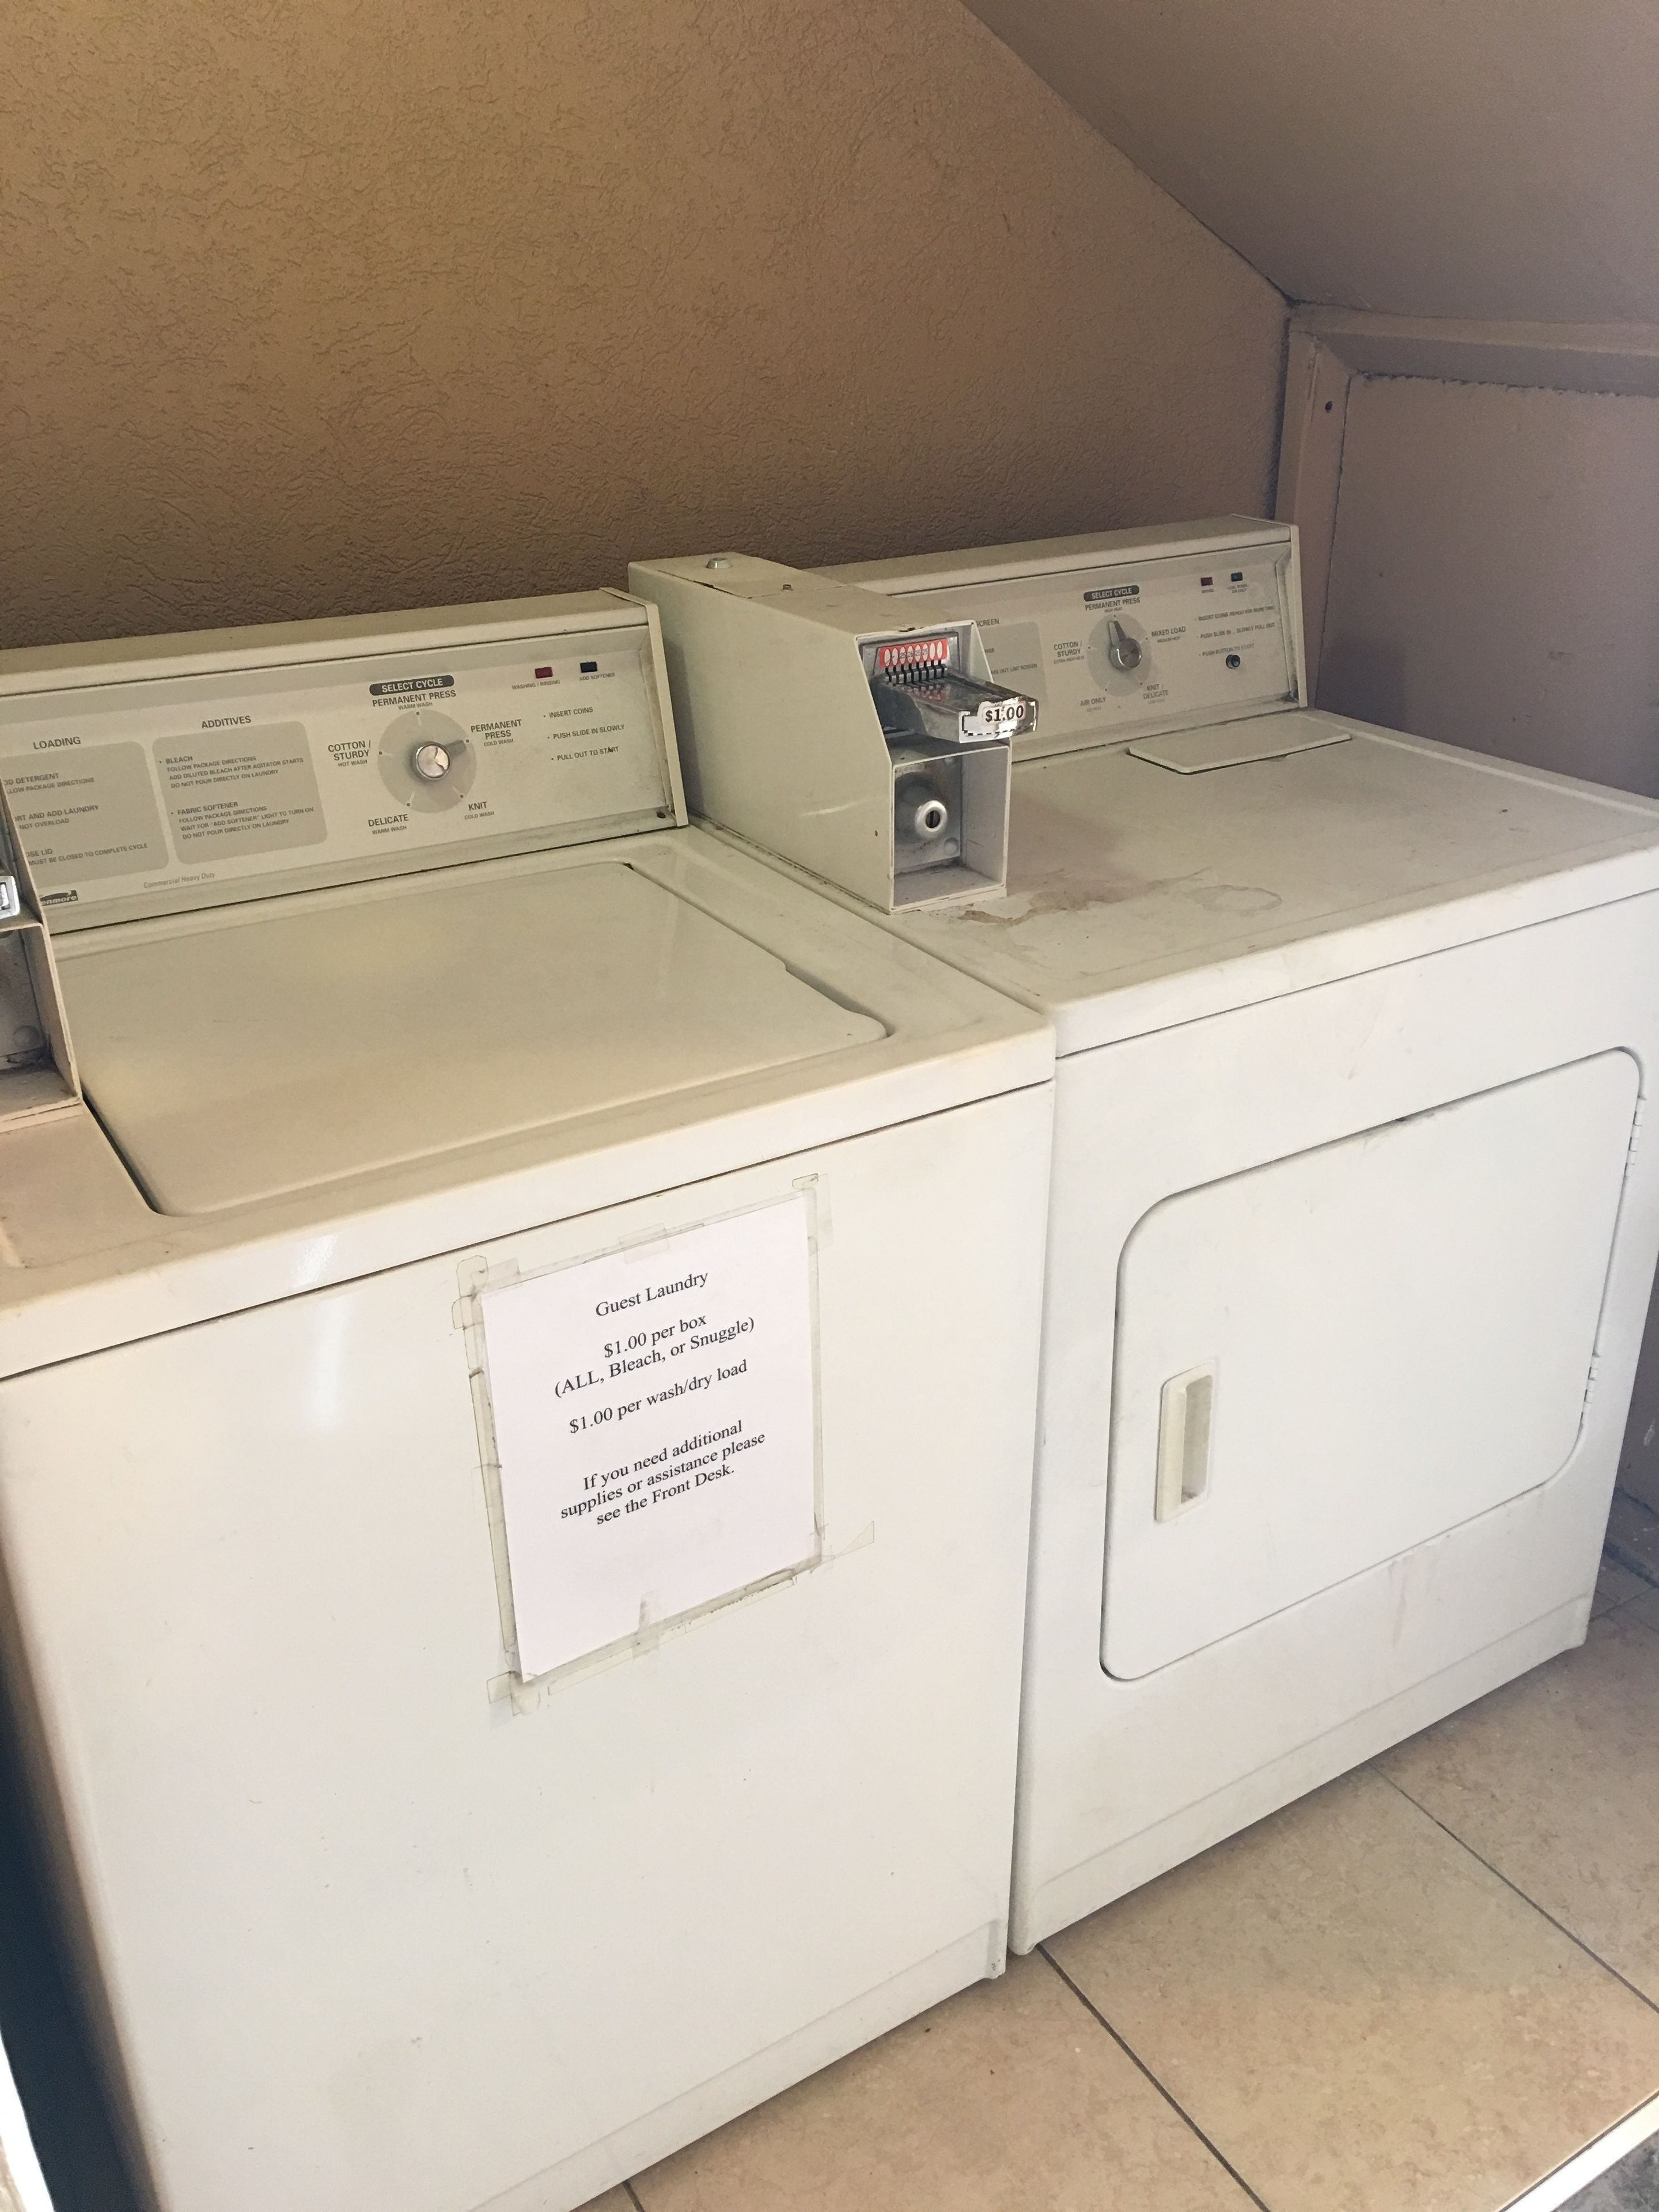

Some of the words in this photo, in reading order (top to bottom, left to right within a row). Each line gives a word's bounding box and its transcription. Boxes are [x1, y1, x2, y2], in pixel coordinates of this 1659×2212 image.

[1092, 591, 1112, 599] SELECT
[1114, 588, 1132, 596] CYCLE
[1085, 600, 1120, 611] PERMANENT
[976, 618, 999, 627] SCREEN
[1152, 628, 1169, 637] MIXED
[1054, 642, 1078, 650] COTTON
[1058, 649, 1080, 657] STURDY
[382, 681, 413, 692] SELECT
[416, 679, 443, 688] CYCLE
[372, 694, 426, 707] PERMANENT
[429, 690, 456, 699] PRESS
[1143, 690, 1169, 699] DELICATE
[549, 710, 571, 718] INSERT
[573, 707, 593, 715] COINS
[984, 704, 1024, 723] $1.00
[202, 715, 251, 729] ADDITIVES
[471, 719, 522, 733] PERMANENT
[485, 730, 512, 740] PRESS
[600, 725, 624, 733] SLOWLY
[33, 736, 81, 749] LOADING
[328, 741, 366, 752] COTTON
[166, 756, 193, 764] BLEACH
[334, 749, 369, 761] STURDY
[194, 760, 220, 769] PACKAGE
[222, 756, 256, 765] DIRECTIONS
[210, 767, 232, 775] BLEACH
[253, 760, 281, 769] AGITATOR
[16, 773, 59, 784] DETERGENT
[213, 774, 239, 783] DIRECTLY
[252, 769, 278, 777] LAUNDRY
[26, 783, 55, 791] PACKAGE
[58, 778, 94, 787] DIRECTIONS
[65, 805, 99, 815] LAUNDRY
[177, 807, 201, 815] FABRIC
[203, 801, 238, 812] SOFTENER
[468, 801, 487, 811] KNIT
[204, 812, 232, 820] PACKAGE
[233, 806, 267, 816] DIRECTIONS
[35, 818, 70, 828] OVERLOAD
[225, 825, 251, 834] DIRECTLY
[263, 819, 289, 827] LAUNDRY
[368, 814, 409, 827] DELICATE
[59, 853, 83, 861] CLOSED
[95, 846, 127, 856] COMPLETE
[143, 877, 180, 889] Commercial
[181, 874, 200, 883] Heavy
[41, 895, 77, 906] enmore
[596, 1293, 642, 1316] Guest
[646, 1272, 709, 1302] Laundry
[604, 1332, 647, 1358] $1.00
[652, 1325, 676, 1346] per
[679, 1314, 708, 1332] box
[554, 1369, 605, 1398] (ALL,
[609, 1351, 666, 1378] Bleach,
[670, 1342, 686, 1357] or
[691, 1317, 755, 1350] Snuggle)
[569, 1408, 613, 1434] $1.00
[618, 1400, 642, 1421] per
[646, 1374, 712, 1406] wash/dry
[717, 1359, 748, 1381] load
[584, 1473, 598, 1490] If
[601, 1466, 629, 1488] you
[634, 1448, 668, 1473] need
[672, 1420, 743, 1457] additional
[560, 1487, 623, 1519] supplies
[627, 1479, 643, 1494] or
[647, 1451, 718, 1486] assistance
[722, 1432, 766, 1460] please
[596, 1508, 621, 1525] see
[625, 1498, 649, 1514] the
[652, 1479, 691, 1504] Front
[695, 1464, 735, 1487] Desk.
